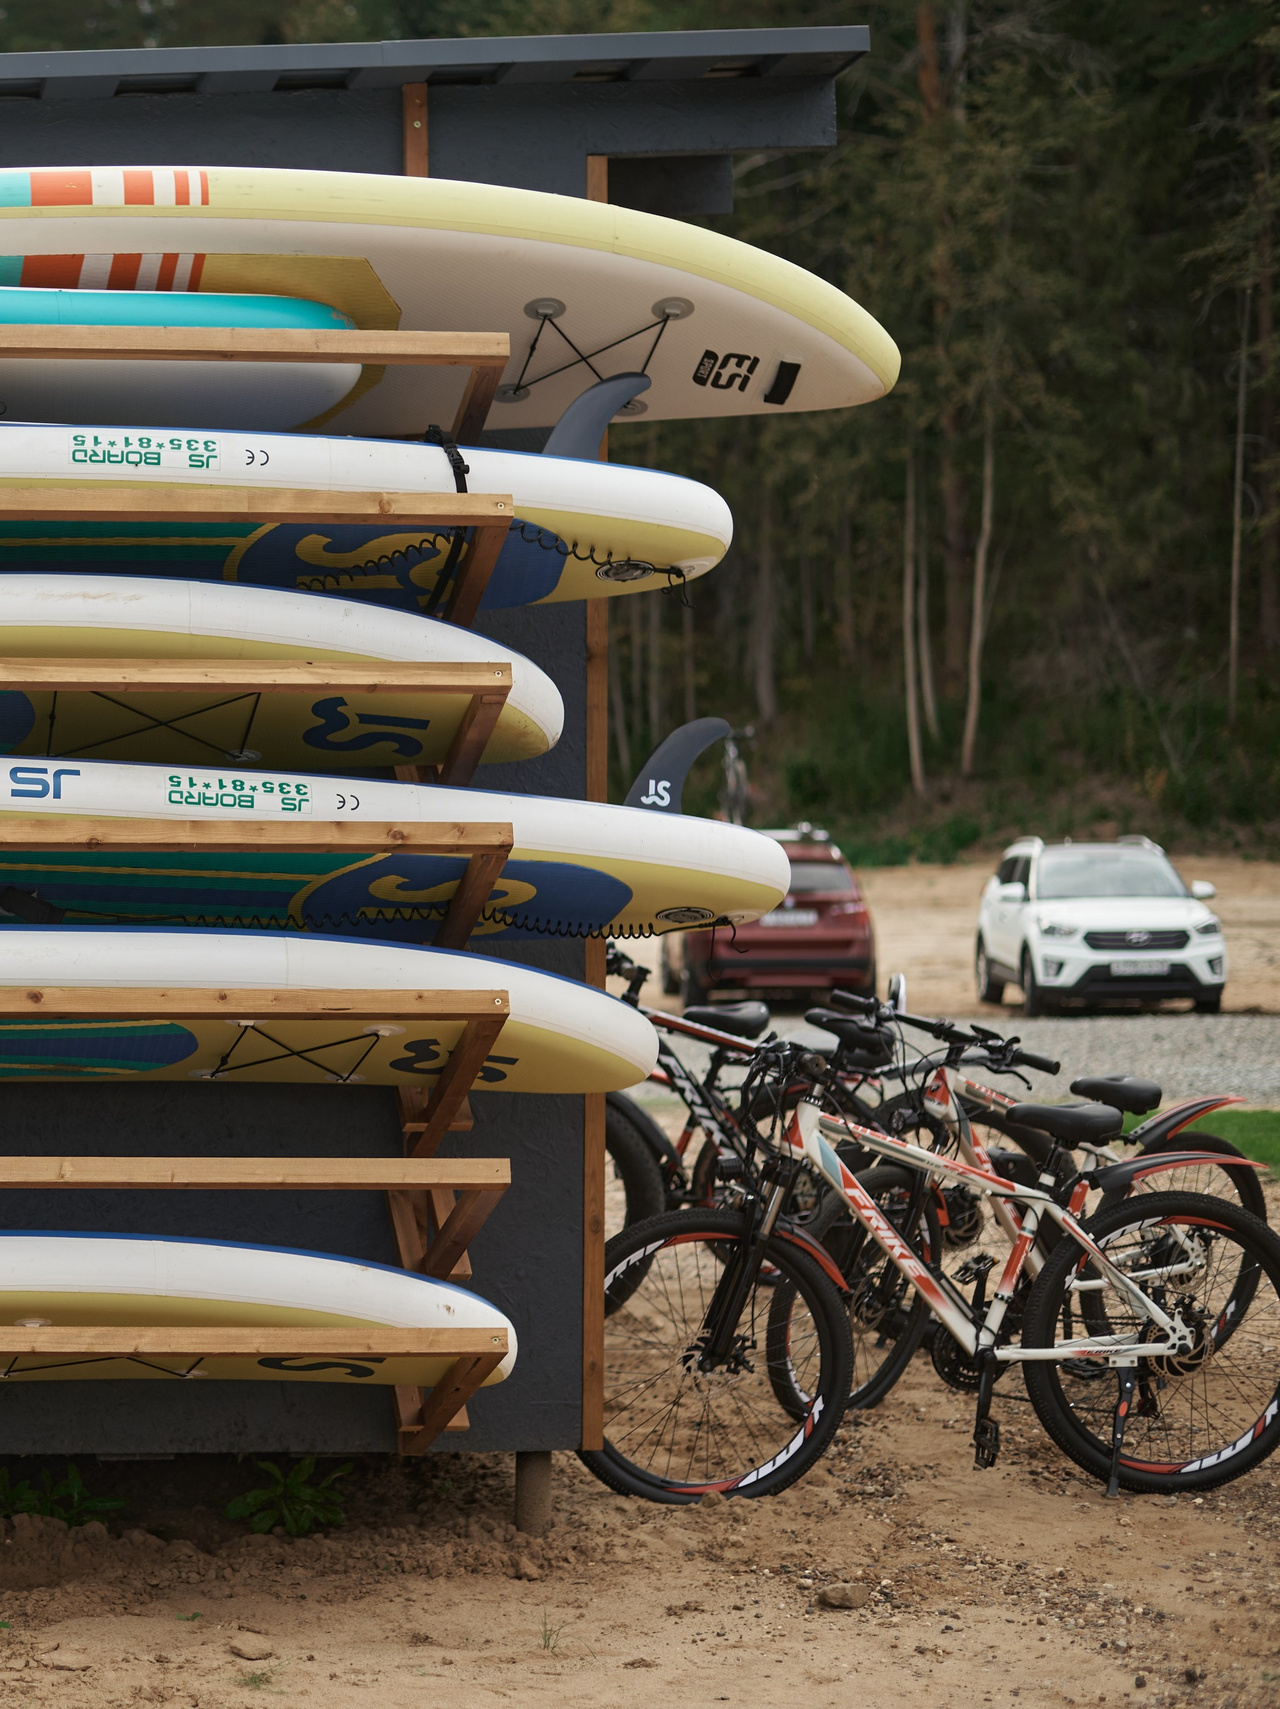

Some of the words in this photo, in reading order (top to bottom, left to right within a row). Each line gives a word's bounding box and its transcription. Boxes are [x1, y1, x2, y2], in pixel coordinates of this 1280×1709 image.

[71, 448, 161, 466] BOARD
[188, 453, 218, 469] JS
[9, 766, 81, 799] JS
[640, 779, 671, 807] JS
[168, 789, 255, 809] BOARD
[280, 797, 309, 812] JS
[659, 1053, 740, 1160] FRIK
[842, 1187, 930, 1279] FRIKE
